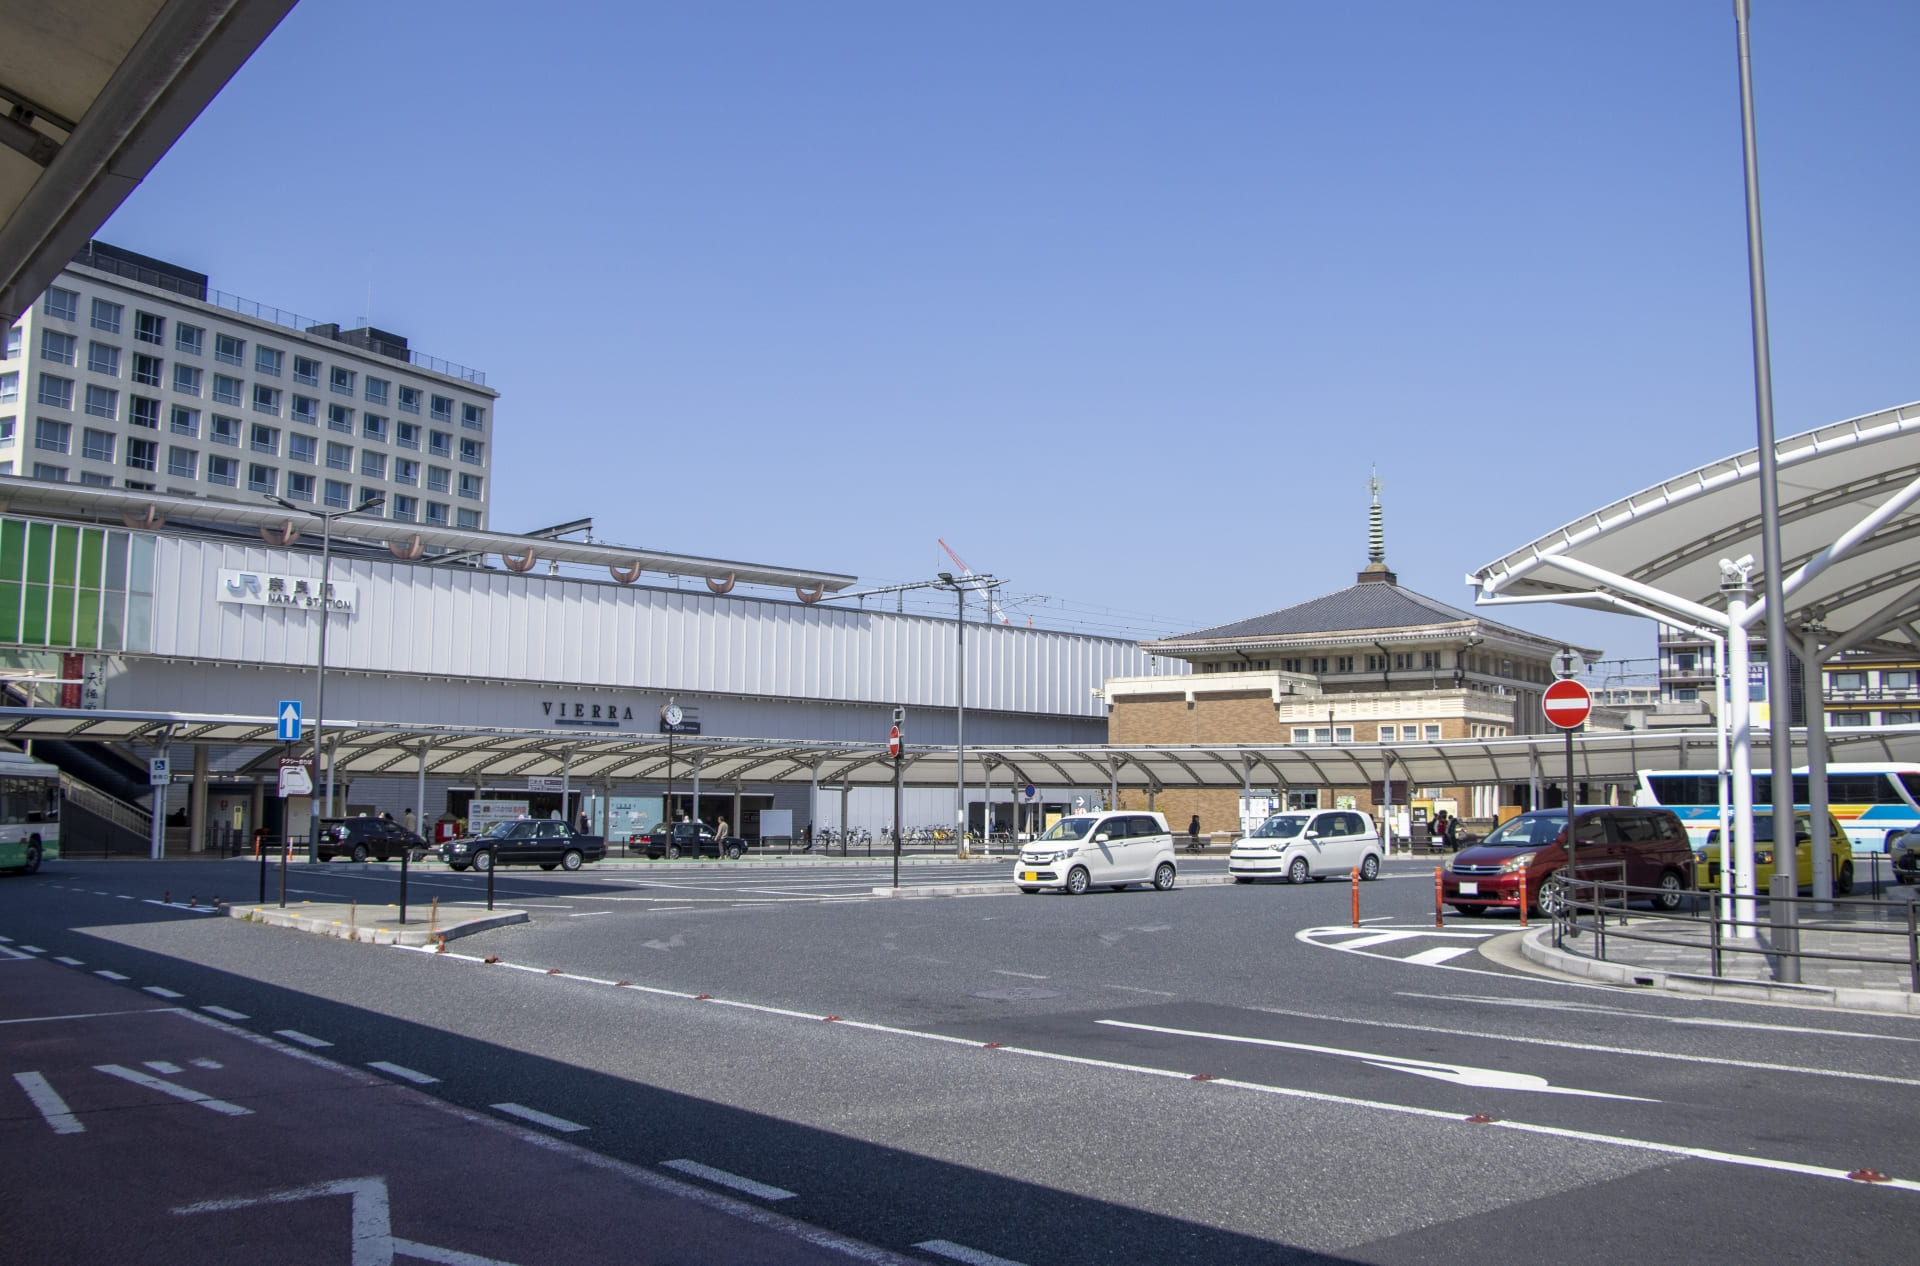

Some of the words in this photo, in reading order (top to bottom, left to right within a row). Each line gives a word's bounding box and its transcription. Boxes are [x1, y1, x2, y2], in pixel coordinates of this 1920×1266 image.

[226, 573, 261, 595] JR
[268, 593, 298, 606] NARA
[305, 597, 351, 610] STTION
[542, 701, 633, 720] VIERRA
